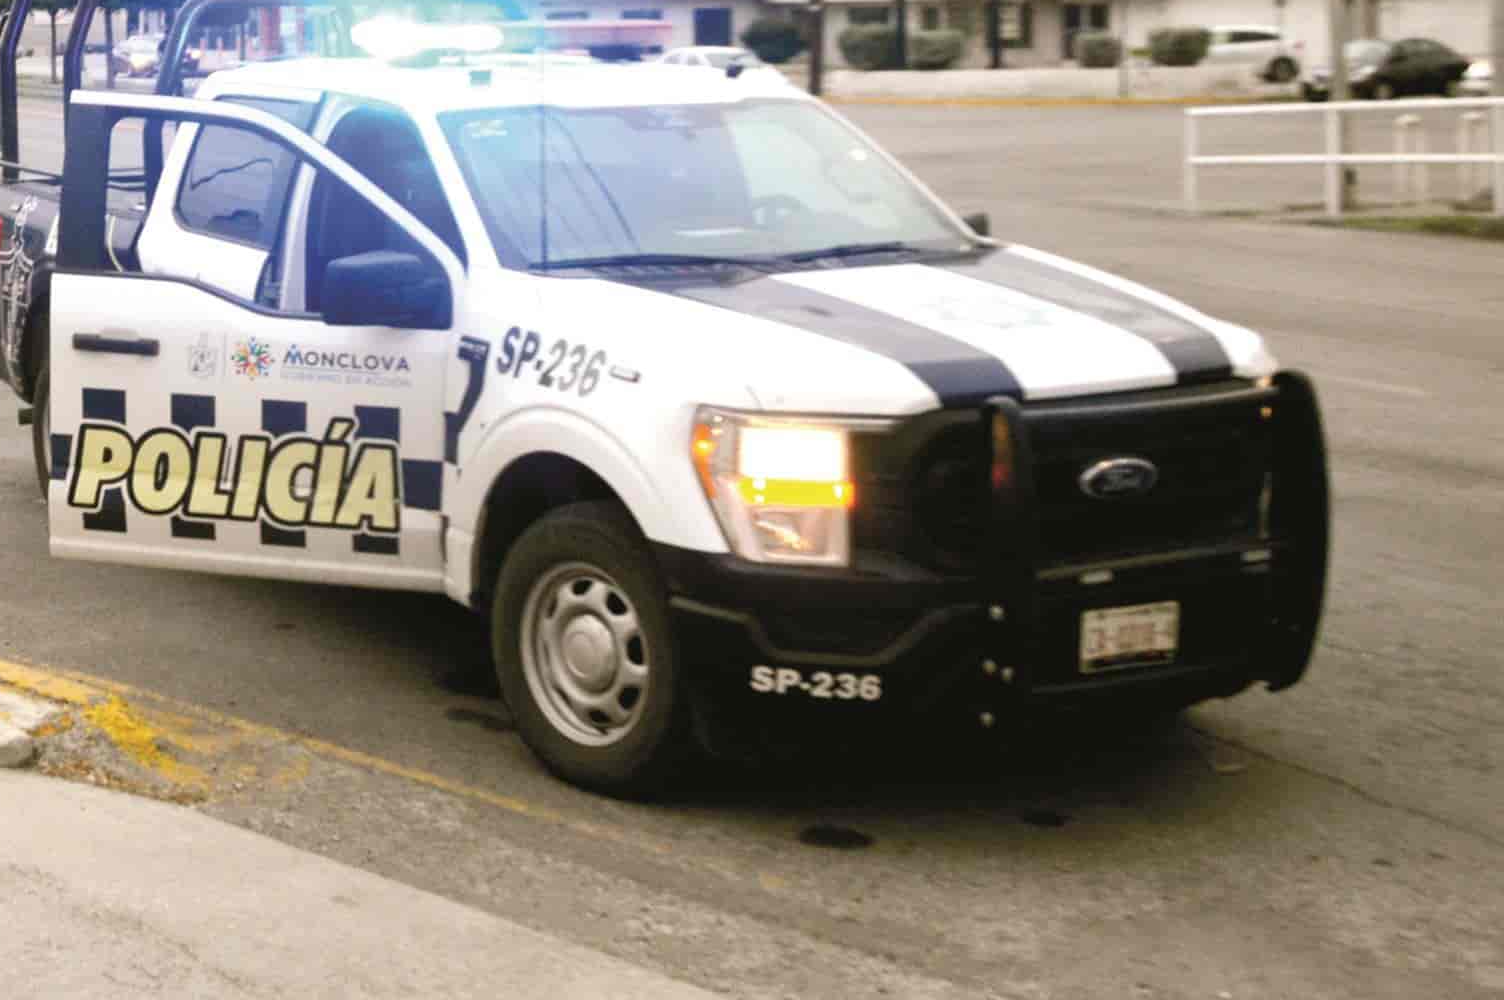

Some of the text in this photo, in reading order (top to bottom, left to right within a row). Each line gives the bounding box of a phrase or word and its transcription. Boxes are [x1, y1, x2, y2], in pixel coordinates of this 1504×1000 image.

[283, 344, 411, 372] MONCLOVA
[497, 325, 607, 397] SP-236
[67, 417, 400, 534] POLICÍA
[749, 664, 882, 701] SP-236
